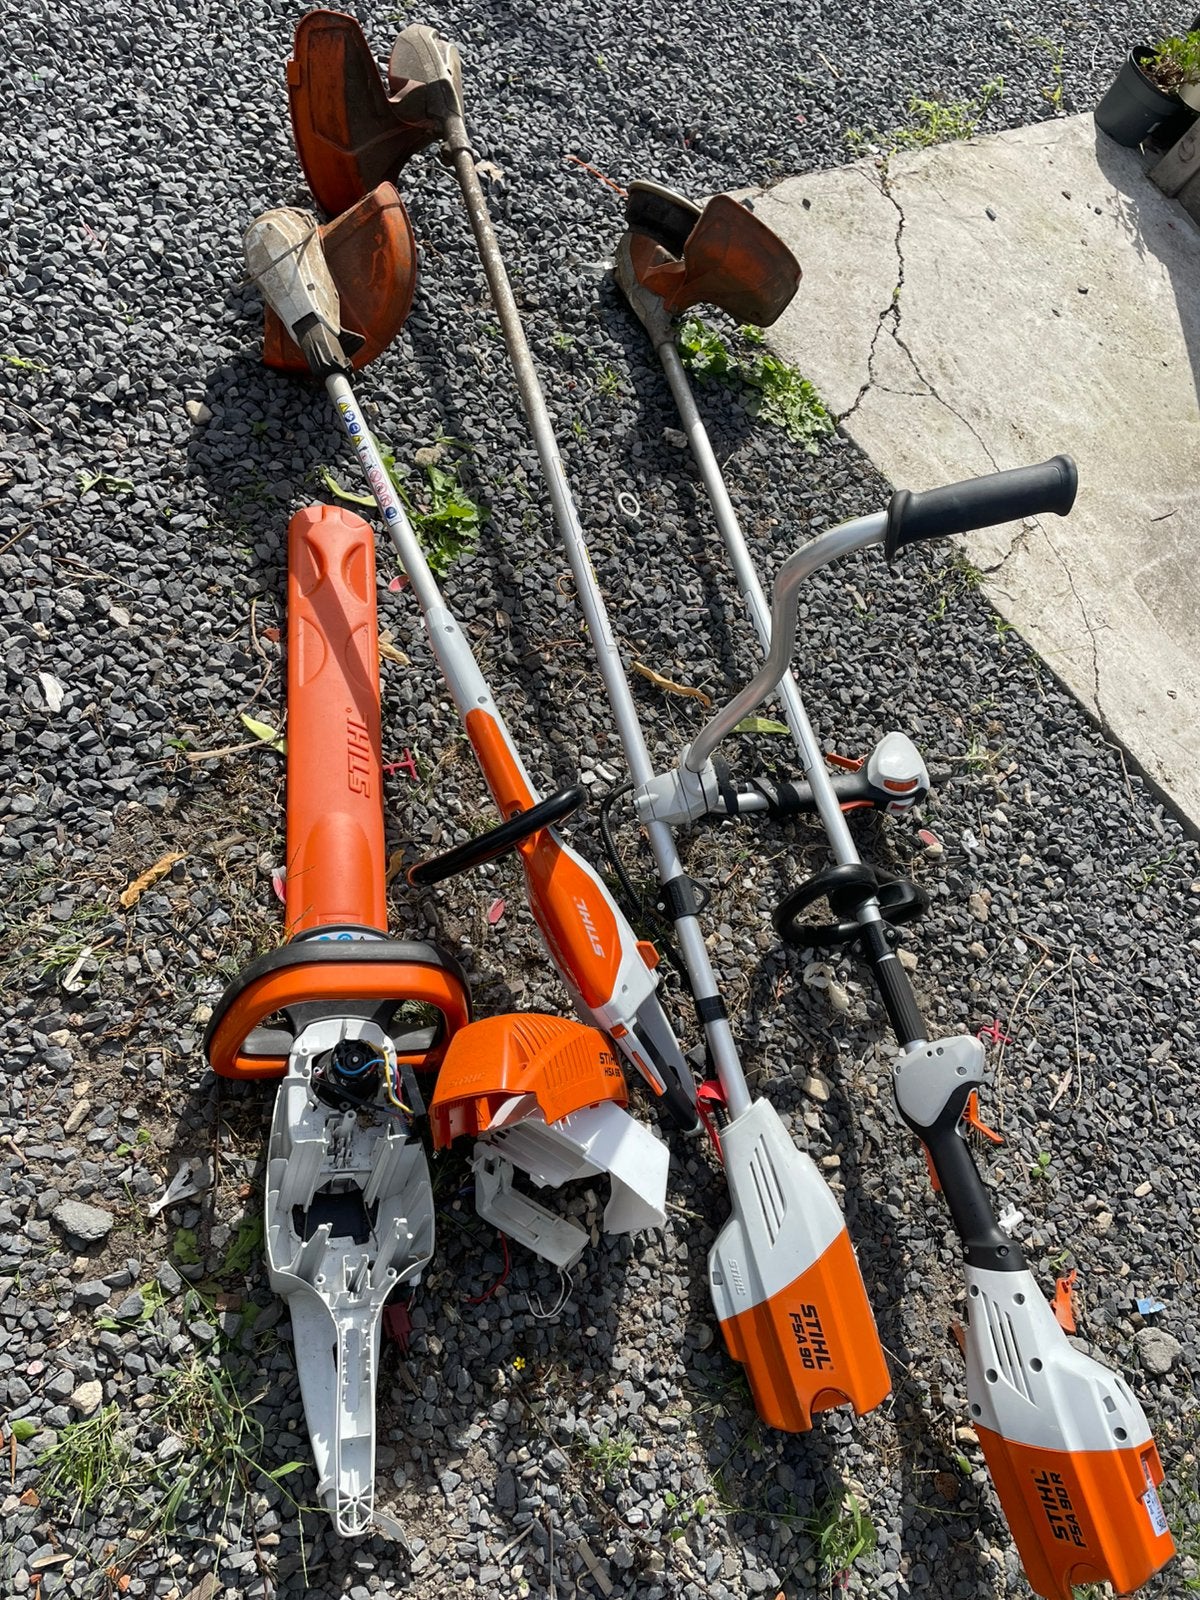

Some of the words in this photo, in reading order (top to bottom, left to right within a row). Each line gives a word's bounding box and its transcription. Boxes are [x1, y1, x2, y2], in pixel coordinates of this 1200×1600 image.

[347, 712, 371, 799] STIHL
[576, 898, 606, 959] STIHL
[728, 1258, 743, 1296] STIHL
[789, 1312, 807, 1345] FSA
[800, 1347, 815, 1370] 90
[800, 1304, 831, 1370] STIHL
[1034, 1470, 1070, 1542] STIHL
[1064, 1514, 1087, 1549] FSA
